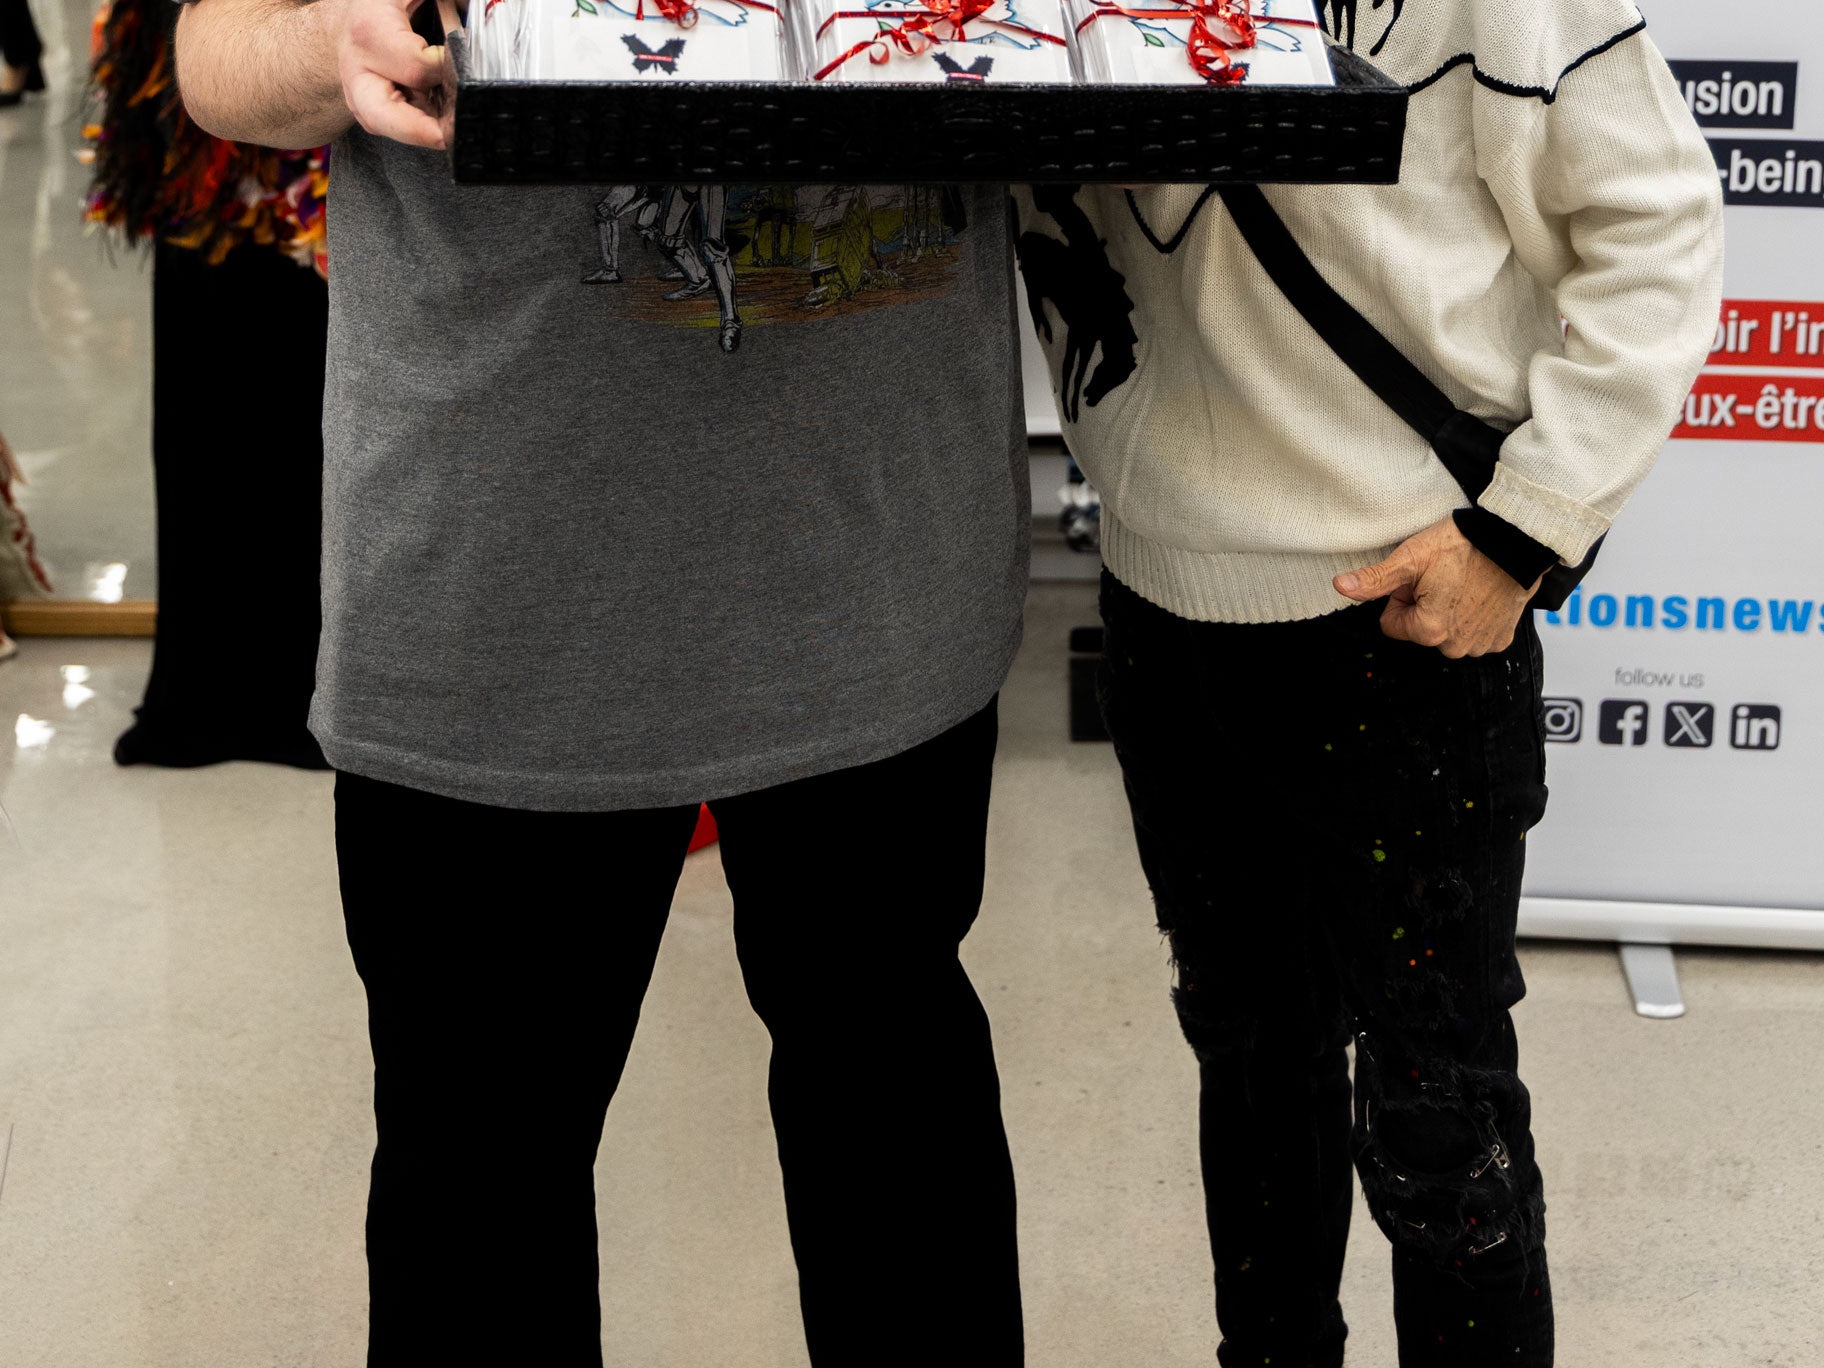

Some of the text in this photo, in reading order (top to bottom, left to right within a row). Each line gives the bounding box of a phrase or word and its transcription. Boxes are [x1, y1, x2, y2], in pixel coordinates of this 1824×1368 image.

[1717, 148, 1824, 198] -bein
[1675, 383, 1824, 431] ux-êtr
[1545, 583, 1824, 633] ionsnew
[1614, 666, 1706, 690] follow us
